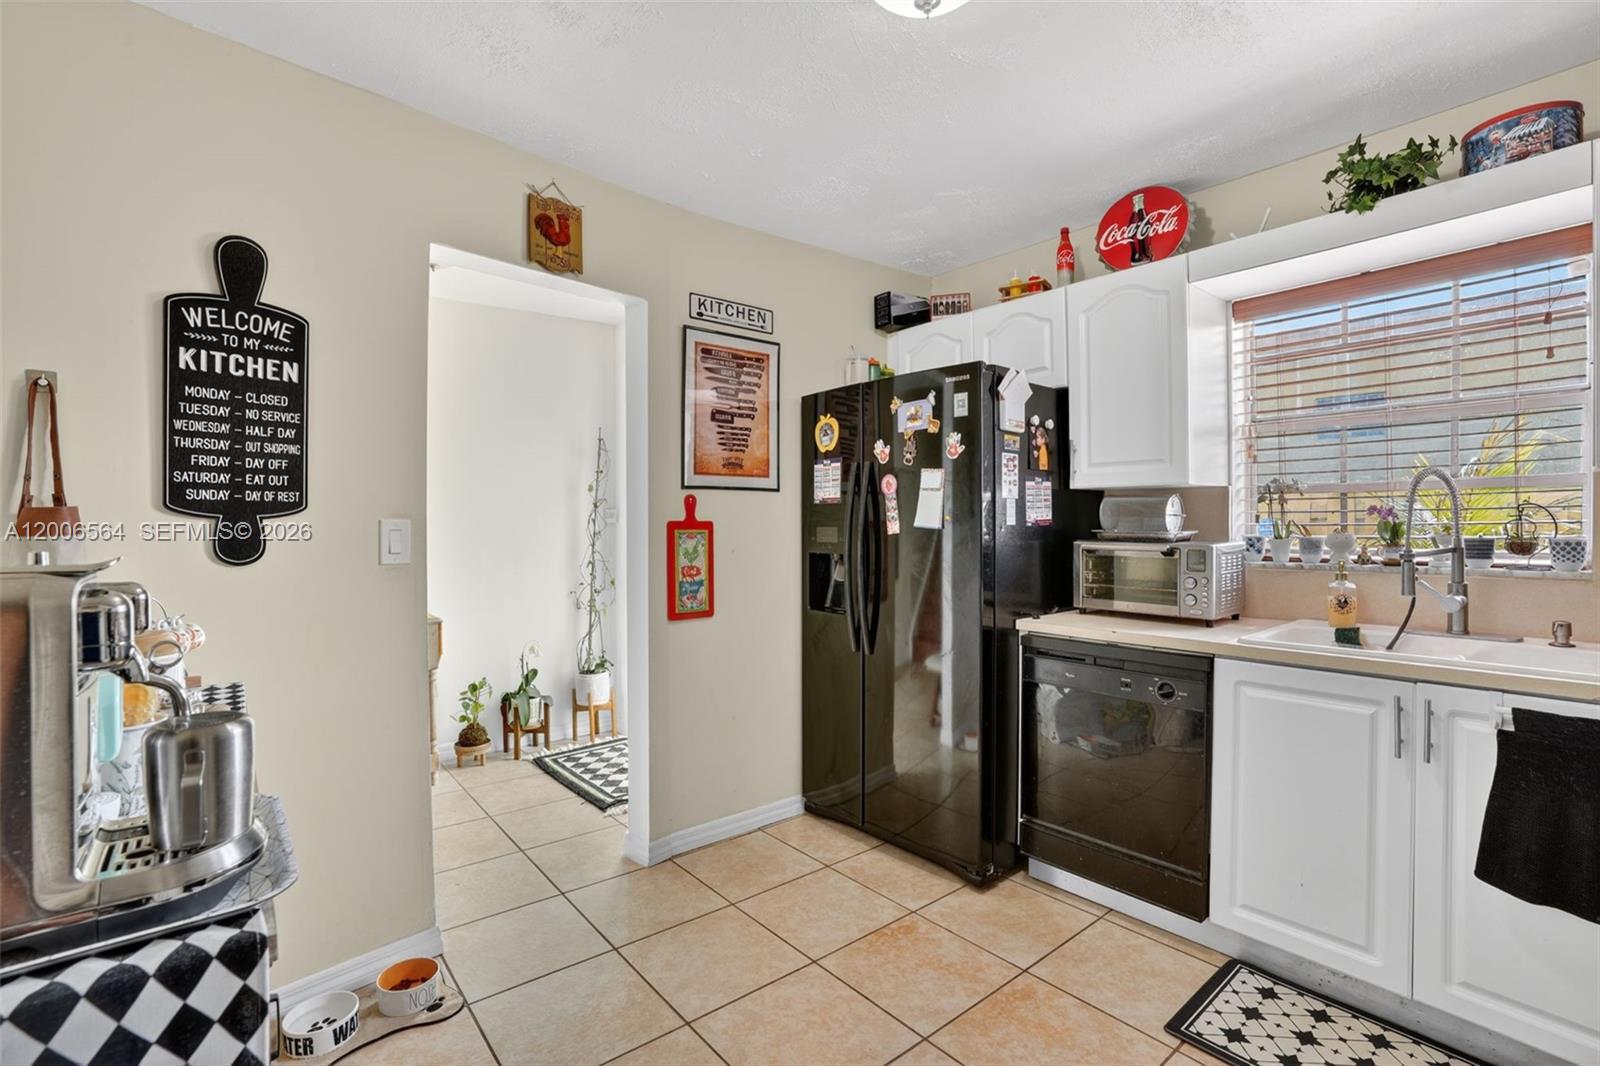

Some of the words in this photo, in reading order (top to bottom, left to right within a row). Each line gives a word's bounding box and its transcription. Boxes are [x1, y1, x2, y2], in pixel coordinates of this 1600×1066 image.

[698, 297, 767, 324] KITCHEN
[181, 307, 295, 343] WELCOME
[221, 333, 239, 347] TO
[244, 337, 261, 350] MY
[178, 346, 299, 383] KITCHEN
[185, 385, 231, 400] MONDAY
[245, 392, 288, 406] CLOSED
[179, 402, 231, 417] TUESDAY
[245, 409, 259, 420] NO
[261, 410, 301, 424] SERVICE
[173, 419, 231, 434] WEDNESDAY
[245, 425, 274, 437] HALF
[277, 427, 296, 439] DAY
[173, 436, 231, 450] THURSDAY
[245, 441, 261, 452] OUT
[263, 442, 301, 455] SHOPPING
[191, 454, 231, 467] FRIDAY
[245, 457, 265, 469] DAY
[268, 459, 289, 470] OFF
[173, 470, 231, 484] SATURDAY
[245, 473, 265, 485] EAT
[268, 475, 289, 486] OUT
[185, 488, 231, 501] SUNDAY
[245, 490, 261, 501] DAY
[264, 491, 276, 501] OF
[277, 491, 301, 503] REST
